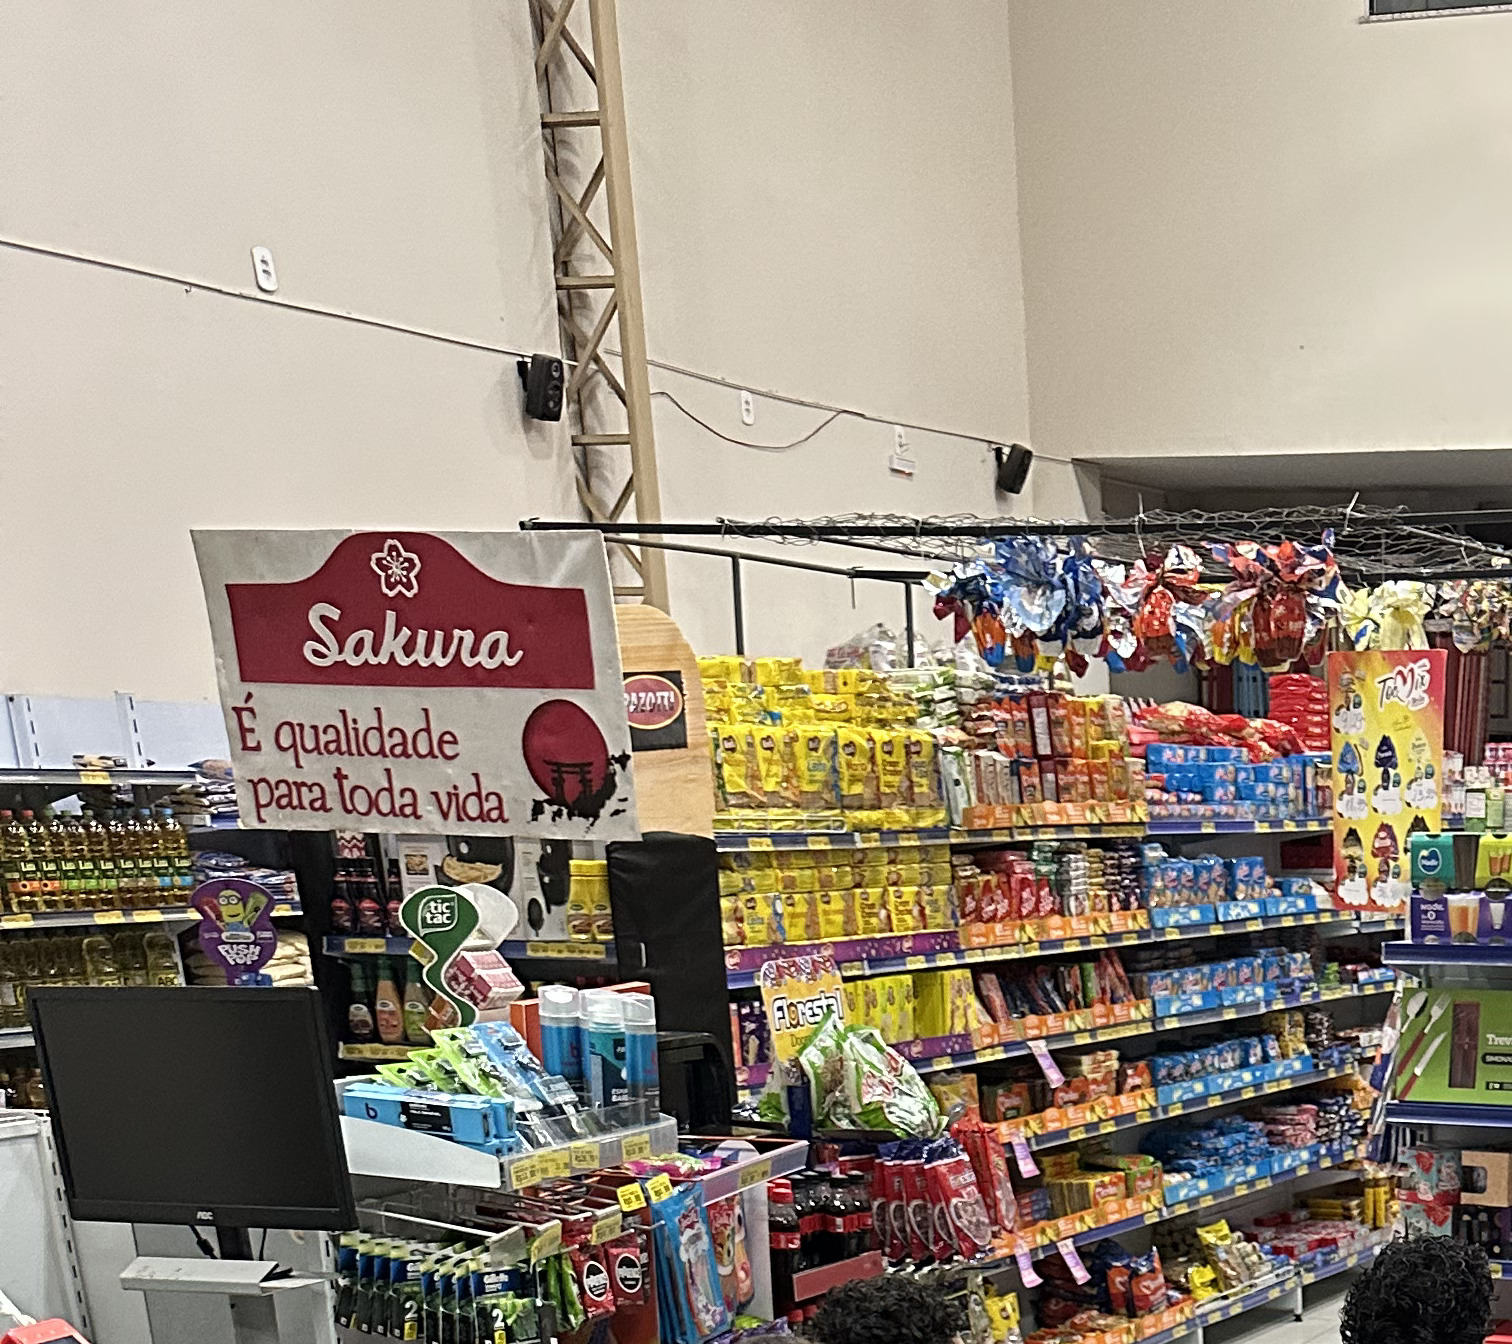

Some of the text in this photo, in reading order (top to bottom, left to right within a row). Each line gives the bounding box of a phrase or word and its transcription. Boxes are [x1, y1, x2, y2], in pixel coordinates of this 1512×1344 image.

[303, 602, 524, 670] Sakura
[232, 692, 460, 768] É qualidade
[248, 766, 510, 824] para toda vida
[429, 899, 451, 913] tic
[425, 912, 452, 924] tac
[217, 944, 261, 957] PUSH
[225, 953, 259, 965] POP
[772, 987, 845, 1031] Florestal
[404, 1300, 418, 1321] 2
[491, 1308, 505, 1329] 2
